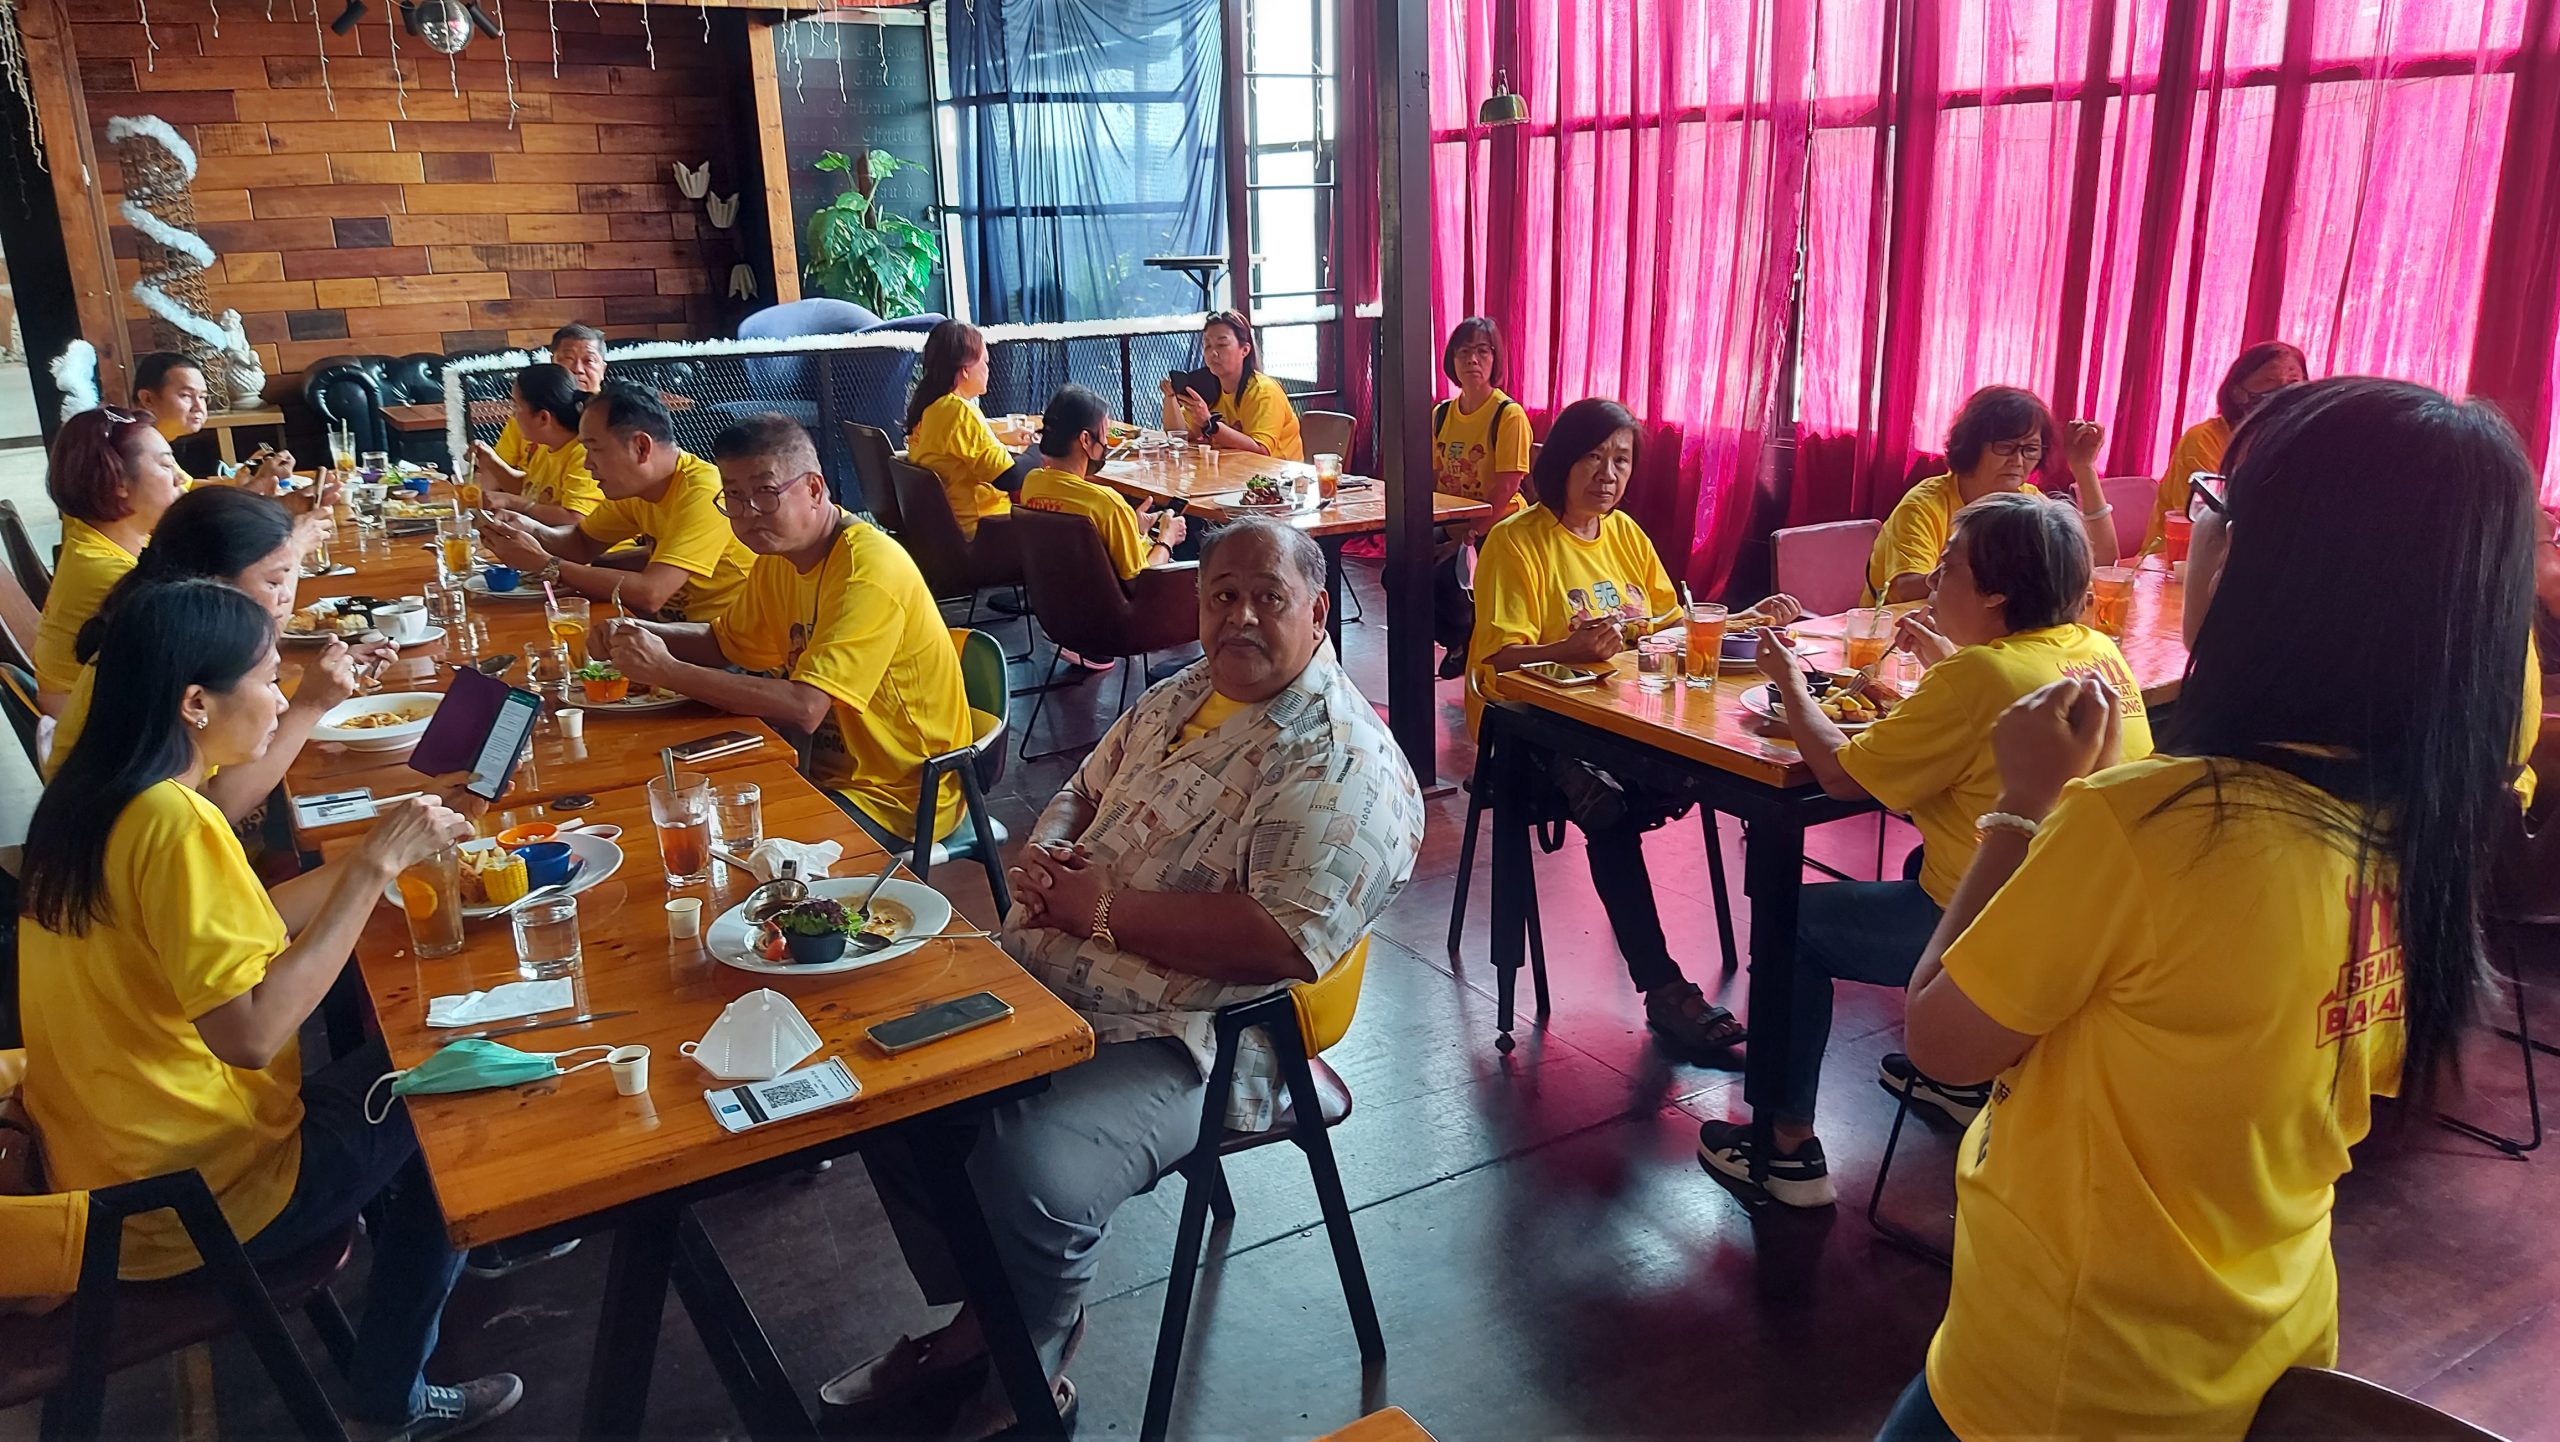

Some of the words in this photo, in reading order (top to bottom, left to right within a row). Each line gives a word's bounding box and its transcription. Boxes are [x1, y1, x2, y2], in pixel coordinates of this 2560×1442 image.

[855, 40, 919, 57] Chrles
[854, 69, 918, 87] Châeau
[2348, 951, 2404, 993] SEMA
[2325, 986, 2403, 1035] BALA
